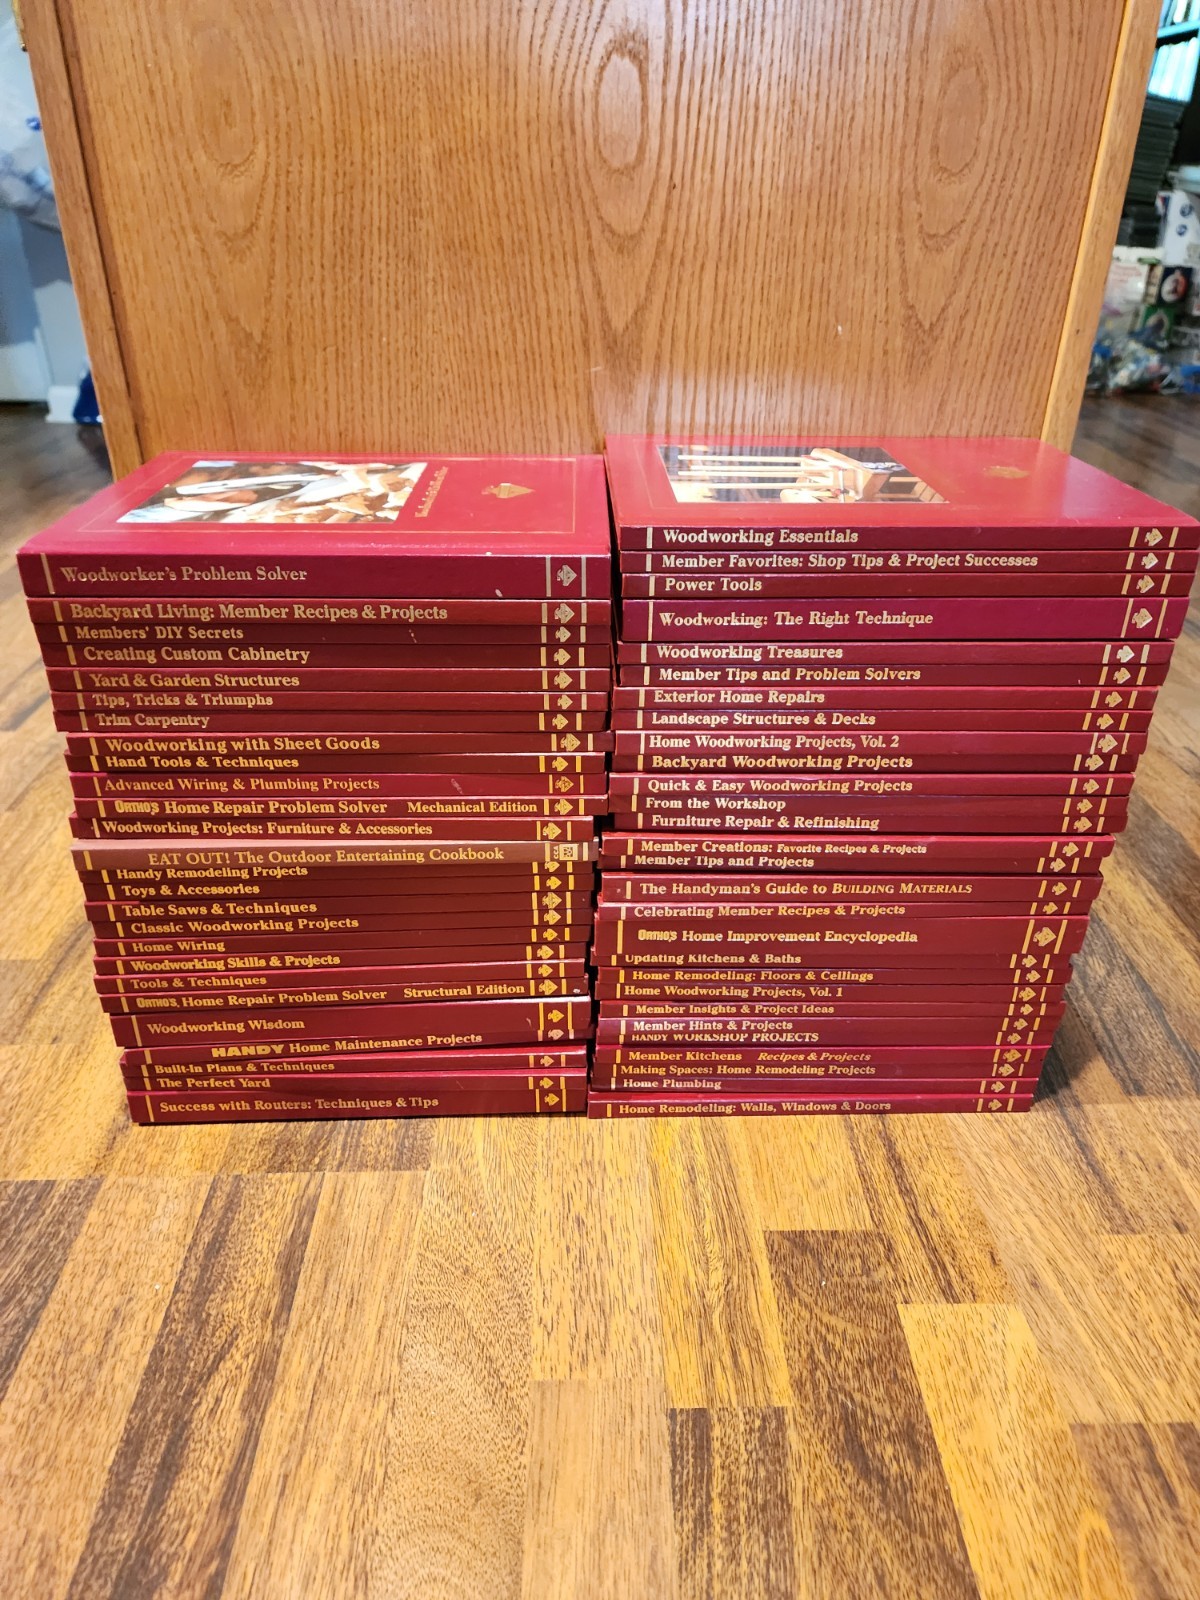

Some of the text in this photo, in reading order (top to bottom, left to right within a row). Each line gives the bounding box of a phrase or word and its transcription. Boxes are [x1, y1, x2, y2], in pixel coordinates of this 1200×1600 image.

[663, 529, 858, 546] Woodworking Essentials
[662, 553, 1038, 570] Member Favorites: Shop Tips & Project Successes
[61, 566, 307, 582] Woodworker's Problem Solver
[665, 578, 762, 591] Power Tools
[70, 604, 448, 622] Backyard Living: Member Recipes & Projects
[659, 611, 933, 629] Woodworking: The Right Technique
[75, 626, 244, 639] Members' DIY Secrets
[84, 647, 310, 664] Creating Custom Cabinetry
[657, 644, 843, 661] Woodworking Treasures
[90, 674, 300, 686] Yard & Garden Structures
[659, 668, 921, 683] Member Tips and Problem Solvers
[92, 693, 273, 708] Tips, Tricks & Triumphs
[654, 691, 825, 706] Exterior Home Repairs
[95, 713, 210, 728] Trim Carpentry
[652, 712, 876, 727] Landscape Structures & Decks
[105, 737, 380, 754] Woodworking with Sheet Goods
[649, 735, 899, 751] Home Woodworking Projects, Vol. 2
[105, 756, 299, 770] Hand Tools & Techniques
[652, 755, 913, 770] Backyard Woodworking Projects
[648, 780, 912, 794] Quick & Easy Woodworking Projects
[646, 797, 786, 812] From the Workshop
[102, 821, 433, 836] Woodworking Projects: Furniture & Accessories
[652, 815, 880, 831] Furniture Repair & Refinishing
[148, 847, 504, 865] EAT OUT! The Outdoor Entertaining Cookbook
[123, 883, 260, 898] Toys & Accessories
[640, 883, 972, 896] The Handyman's Guide to BUILDING MATERIALS
[122, 902, 317, 916] Table Saws & Techniques
[131, 918, 359, 933] Classic Woodworking Projects
[132, 941, 226, 952] Home Wiring
[130, 976, 267, 988] Tools & Techniques
[633, 971, 873, 982] Home Remodeling: Floors & Ceilings
[624, 986, 842, 998] Home Woodworking Projects, Vol. 1
[147, 1020, 305, 1034] Woodworking Wisdom
[633, 1021, 792, 1032] Member Hints & Projects
[211, 1034, 482, 1057] HANDY Home Maintenance Projects
[629, 1052, 871, 1062] Member Kitchens Recipes & Projects
[157, 1078, 270, 1087] The Perfect Yard
[623, 1079, 721, 1090] Home Plumbing
[160, 1097, 439, 1112] Success with Routers: Techniques & Tips
